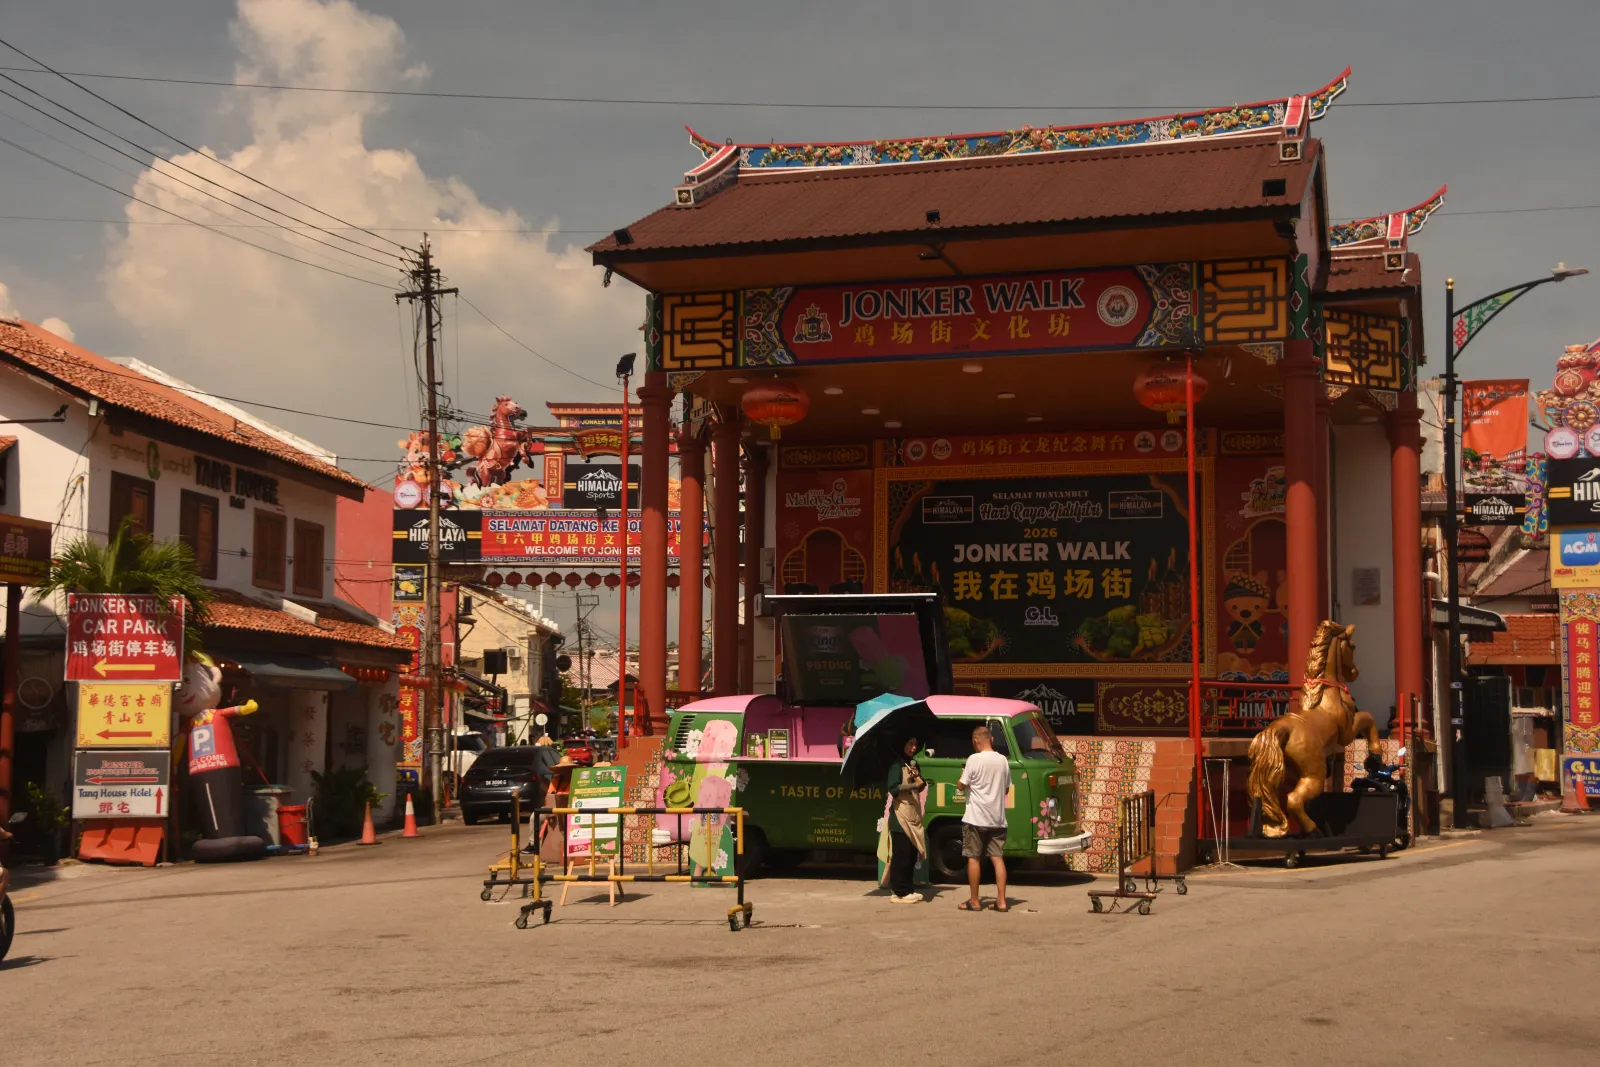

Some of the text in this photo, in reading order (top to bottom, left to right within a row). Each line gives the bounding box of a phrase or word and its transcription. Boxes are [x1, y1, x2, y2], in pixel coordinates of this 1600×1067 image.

[839, 284, 975, 327] JONKER
[985, 278, 1085, 313] WALK
[854, 314, 1071, 347] 鸡场街文化坊
[962, 434, 1126, 457] 鸡场街文龙纪念舞台
[194, 455, 279, 504] TANG HOUSE
[577, 480, 623, 492] HIMALAYA
[586, 491, 616, 501] Sports
[992, 490, 1089, 500] SELAMAT MENYAMBUT
[932, 506, 963, 515] HIMALAYA
[1119, 501, 1152, 510] HIMALAYA
[1473, 504, 1514, 515] HIMALAYA
[979, 503, 1010, 521] Hari
[1011, 501, 1048, 524] Raya
[1480, 514, 1506, 524] Sports
[489, 519, 546, 532] SELAMAT
[549, 519, 598, 533] DATANG
[601, 519, 619, 533] KE
[1023, 527, 1058, 538] 2026
[409, 528, 466, 541] HIMLAYA
[419, 541, 454, 551] Srts
[525, 545, 578, 555] WELCOME
[581, 545, 596, 555] TO
[598, 545, 641, 555] JONER
[953, 541, 1132, 563] JONKER WALK
[1563, 541, 1598, 555] AGM
[953, 568, 1133, 601] 我在鸡场街
[72, 598, 126, 613] JONKER
[83, 619, 168, 634] CAR PARK
[72, 640, 176, 657] 鸡场街停车场
[1575, 622, 1592, 724] 骏马奔腾迎客至
[193, 728, 210, 751] P
[101, 760, 144, 768] JONKER
[78, 788, 152, 800] Tang House Hotel
[780, 786, 882, 799] TASTE OF ASIA
